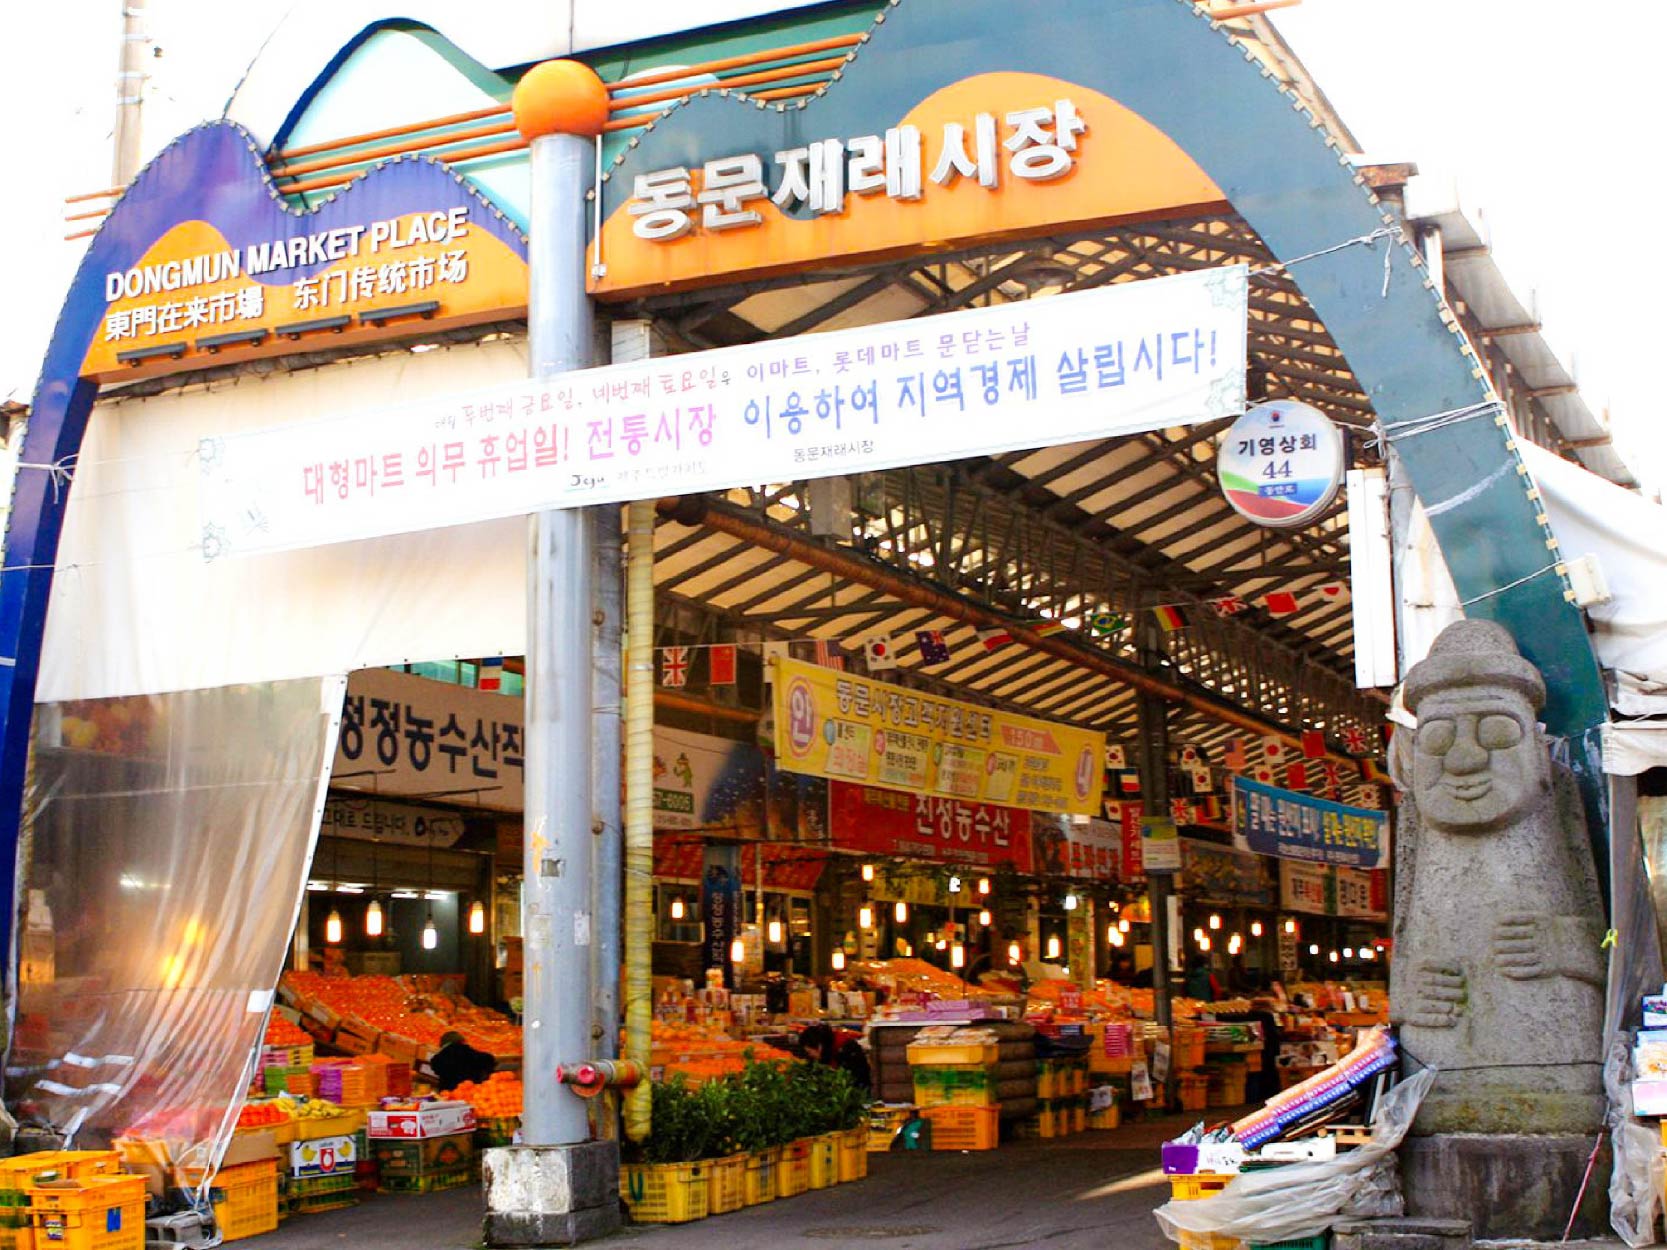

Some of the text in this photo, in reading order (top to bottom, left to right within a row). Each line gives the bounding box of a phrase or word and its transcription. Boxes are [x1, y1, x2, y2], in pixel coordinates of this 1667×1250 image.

[627, 97, 1086, 241] 동문재래시장
[105, 207, 470, 302] DONGMUN MARKET PLACE
[293, 249, 468, 310] 东门传统市场
[593, 375, 650, 404] 네번째
[833, 338, 924, 374] 롯데마트
[303, 327, 1217, 505] 대형마트 의무 휴업일! 전통시장 이용하여 지역경제 살립시다!
[1238, 433, 1317, 457] 기영상회
[793, 440, 874, 463] 동문재래시장
[1262, 459, 1293, 479] 44
